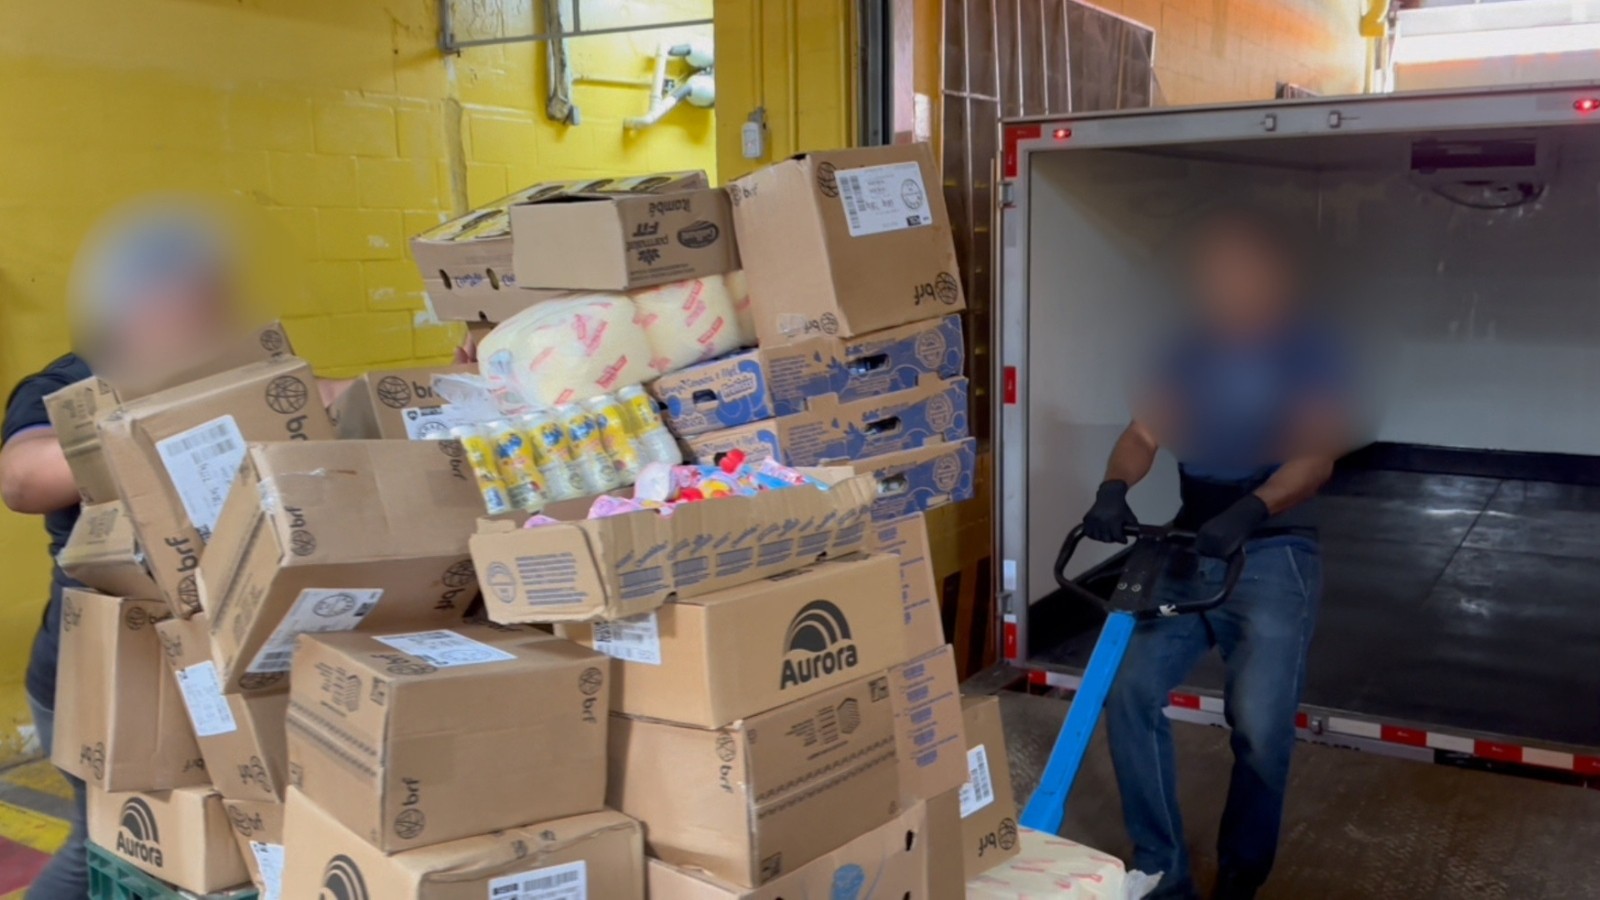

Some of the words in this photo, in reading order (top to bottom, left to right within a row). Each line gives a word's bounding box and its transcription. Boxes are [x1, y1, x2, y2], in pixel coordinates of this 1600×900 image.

[632, 221, 659, 237] FIT
[914, 283, 938, 305] brf
[449, 459, 468, 480] brf
[284, 505, 306, 528] brf
[164, 536, 198, 572] brf
[780, 644, 858, 690] Aurora
[582, 697, 597, 724] brf
[402, 778, 420, 806] brf
[720, 765, 734, 793] brf
[117, 830, 164, 868] Aurora
[978, 832, 997, 858] brf
